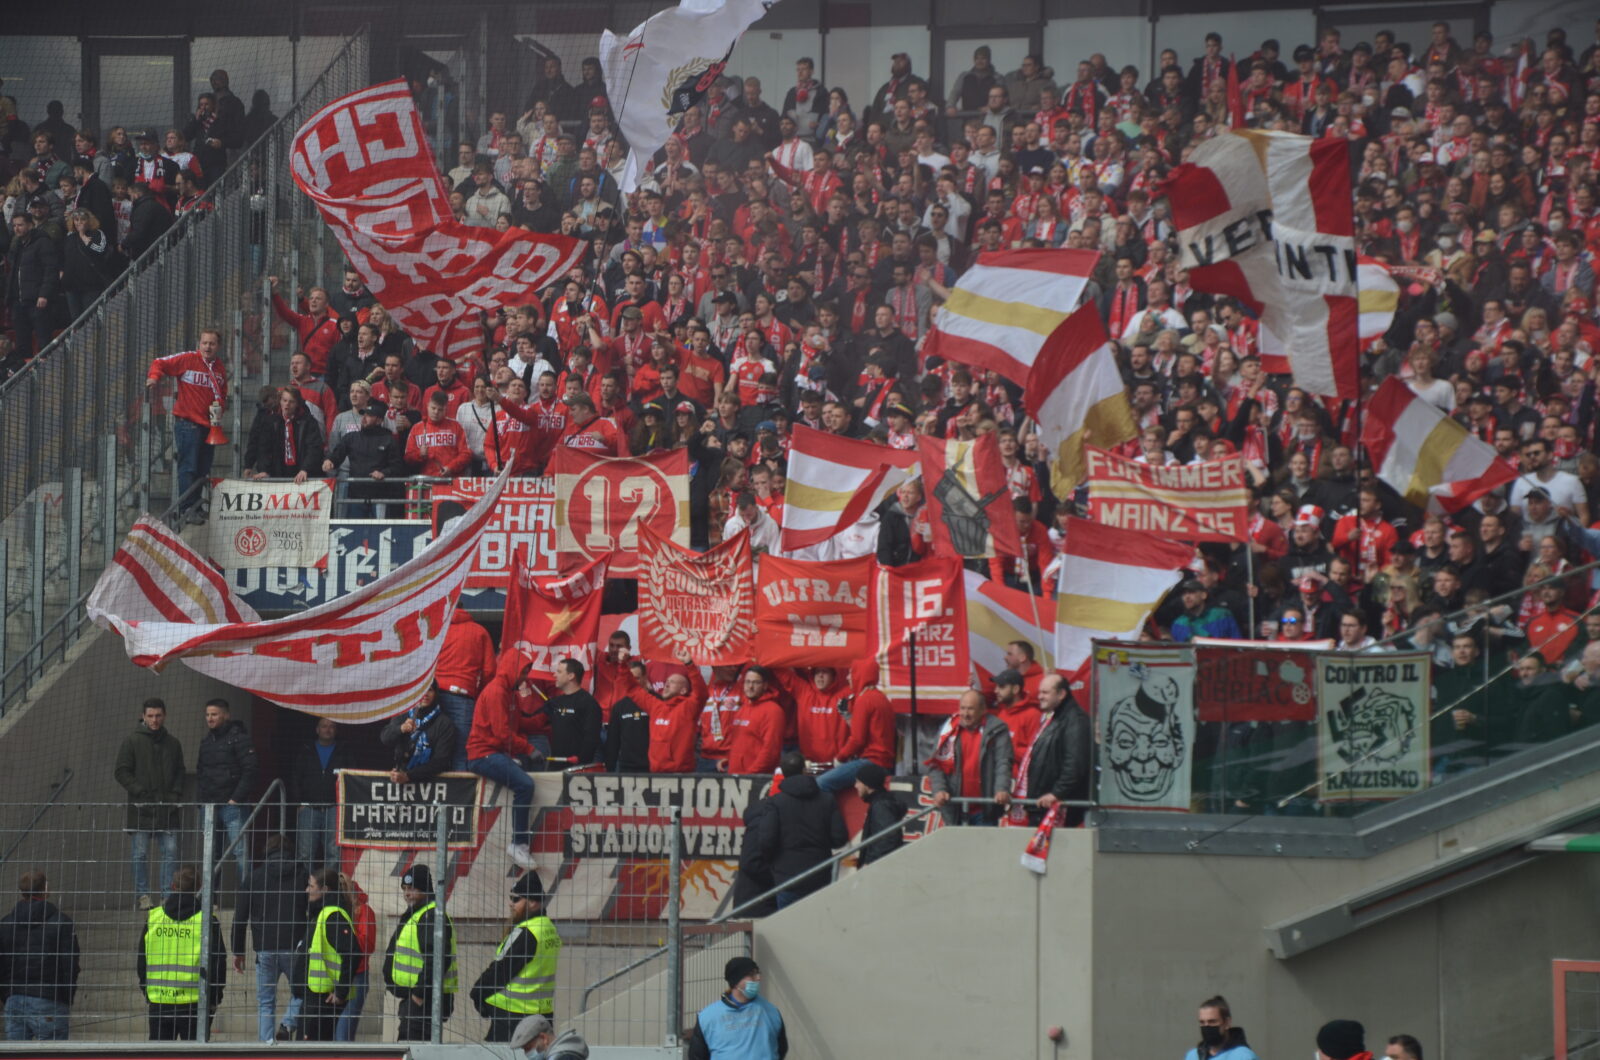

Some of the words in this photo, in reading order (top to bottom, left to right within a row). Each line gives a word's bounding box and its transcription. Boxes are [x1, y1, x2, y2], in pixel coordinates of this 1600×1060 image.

[1150, 459, 1241, 489] IMMER
[219, 490, 322, 512] MBMM
[485, 504, 556, 531] CHA
[583, 475, 661, 553] 12
[1101, 502, 1189, 534] MAINZ
[1196, 511, 1237, 537] 05
[272, 529, 302, 540] since
[1325, 664, 1398, 684] CONTRO
[1402, 663, 1419, 682] IL
[1326, 770, 1419, 791] RAZZISMO
[371, 782, 448, 801] CURVA
[568, 776, 753, 818] SEKTION
[352, 804, 465, 824] PARADIO
[156, 927, 191, 939] ORDNER
